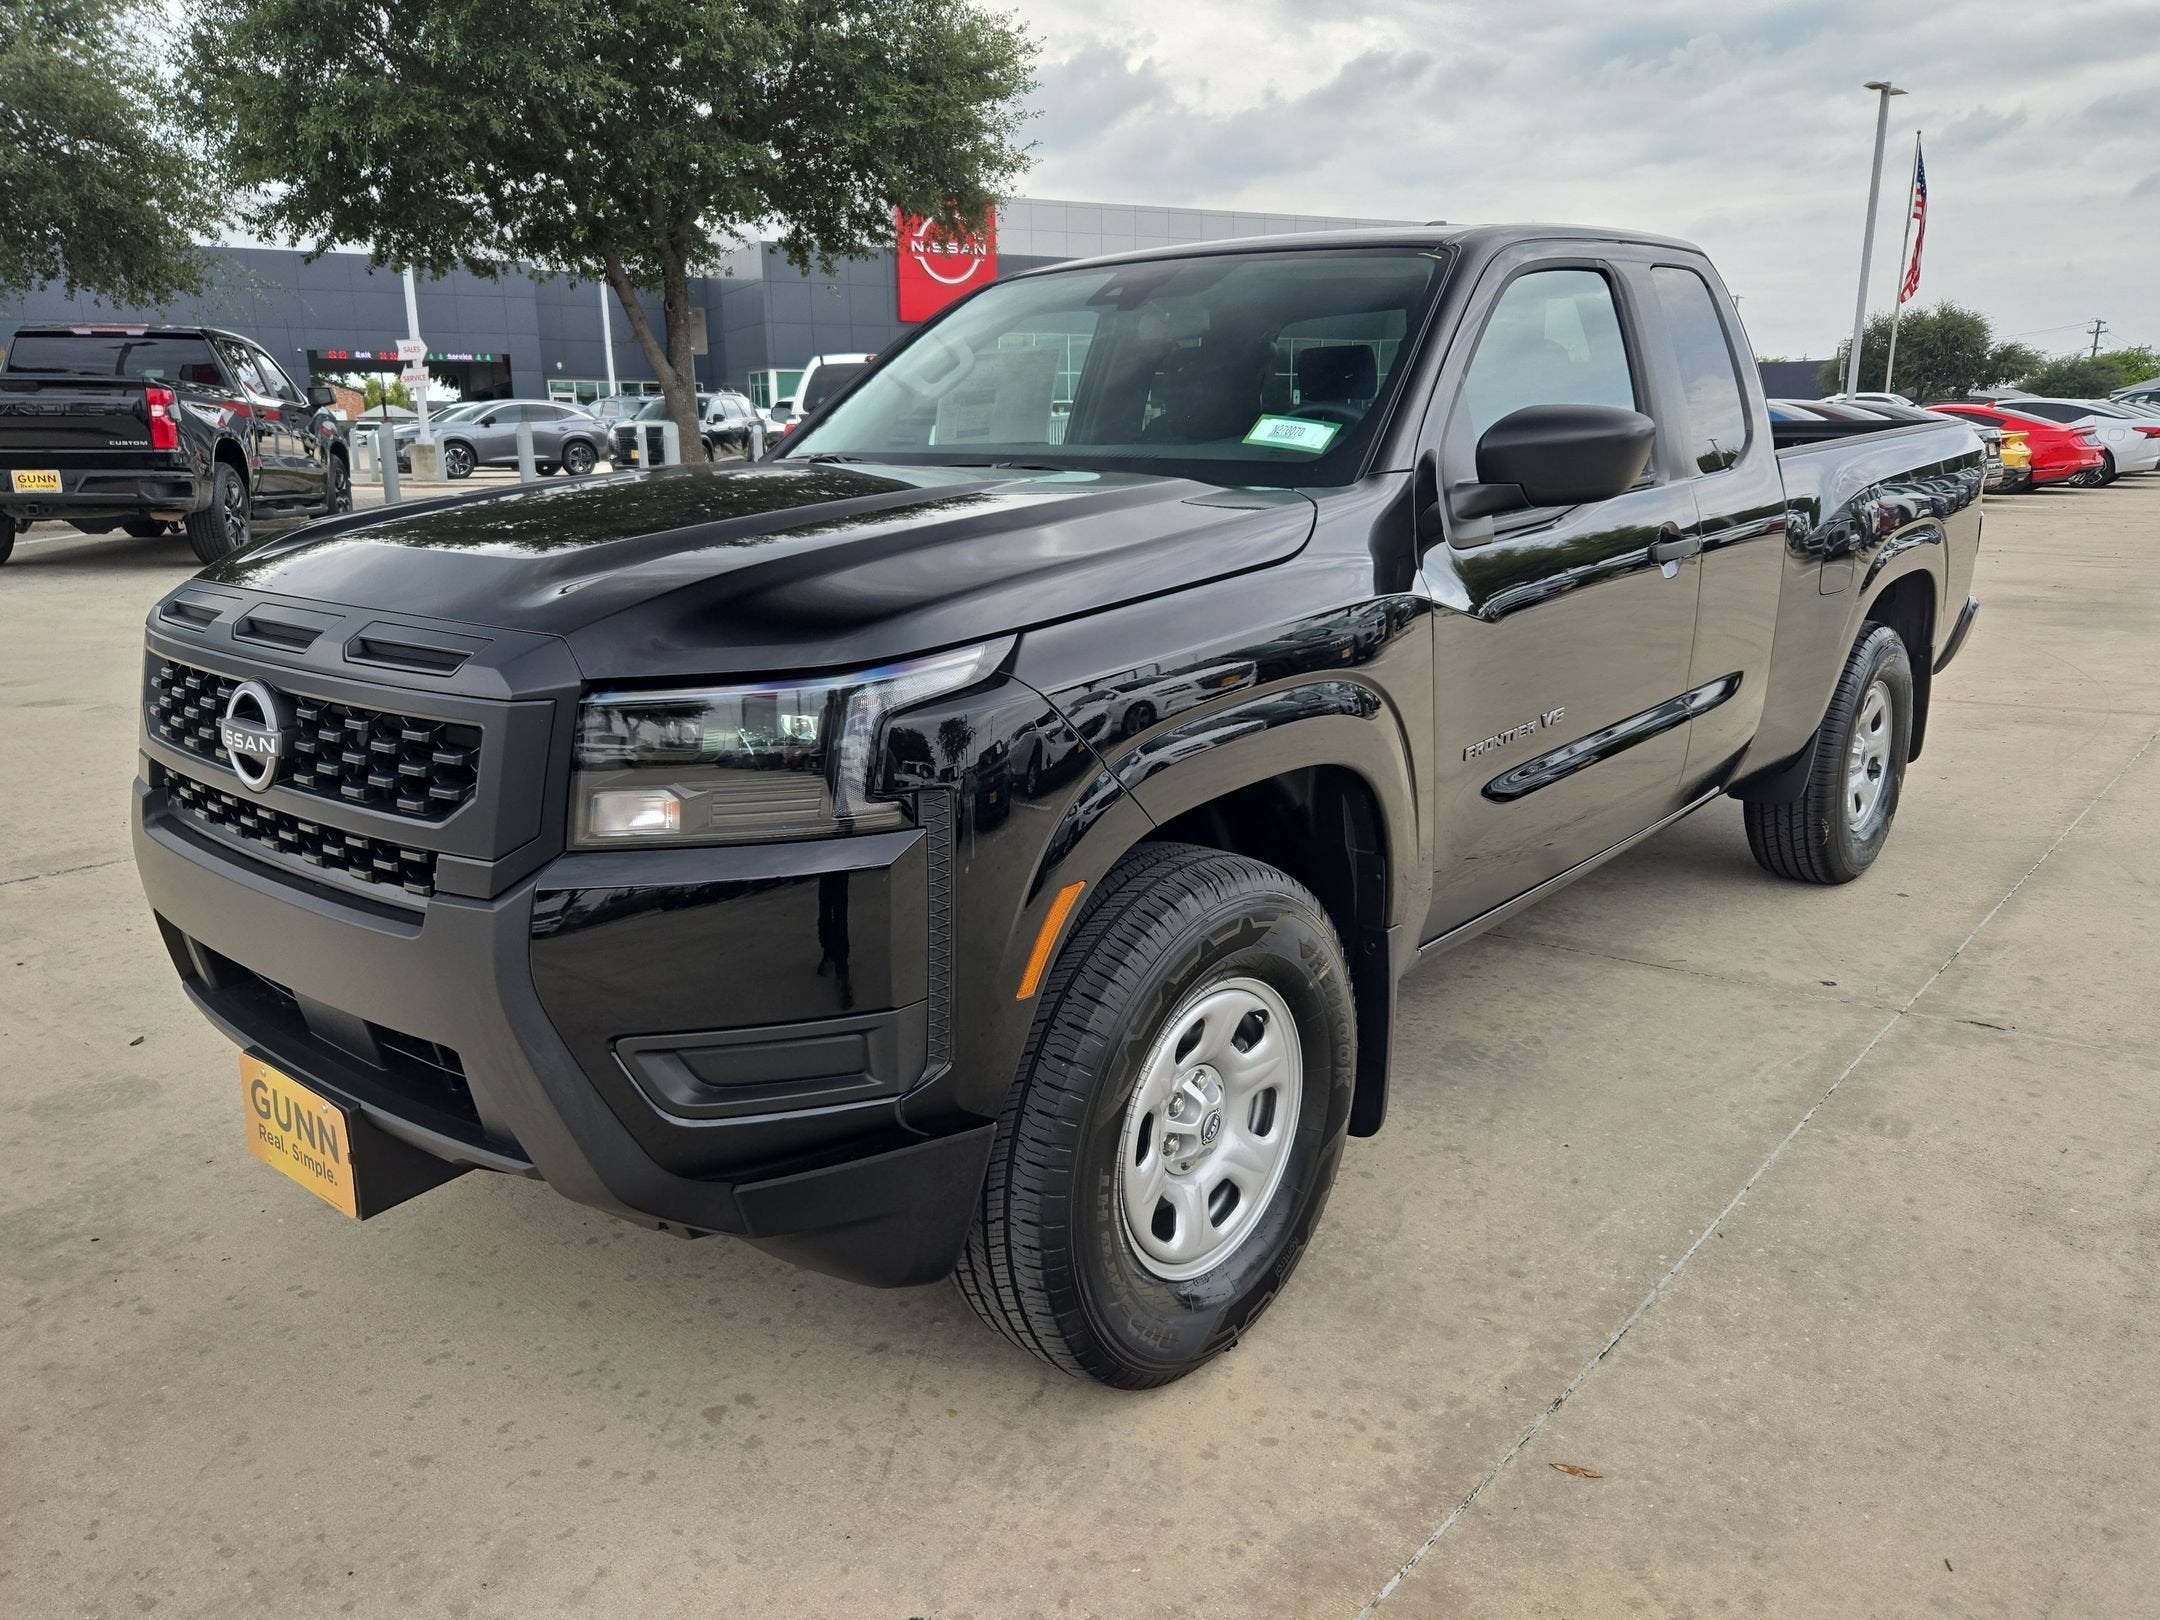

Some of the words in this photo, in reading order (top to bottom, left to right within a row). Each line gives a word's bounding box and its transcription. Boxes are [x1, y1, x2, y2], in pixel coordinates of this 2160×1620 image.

[402, 345, 422, 353] SALES
[446, 353, 473, 361] Service
[402, 374, 427, 382] SERVICE
[17, 474, 57, 483] GUNN
[225, 729, 276, 754] SSAN
[1462, 720, 1537, 762] FRONTIER
[1540, 705, 1566, 729] V6
[250, 1078, 340, 1165] GUNN
[258, 1121, 289, 1156] Real.
[291, 1142, 339, 1188] Simple.
